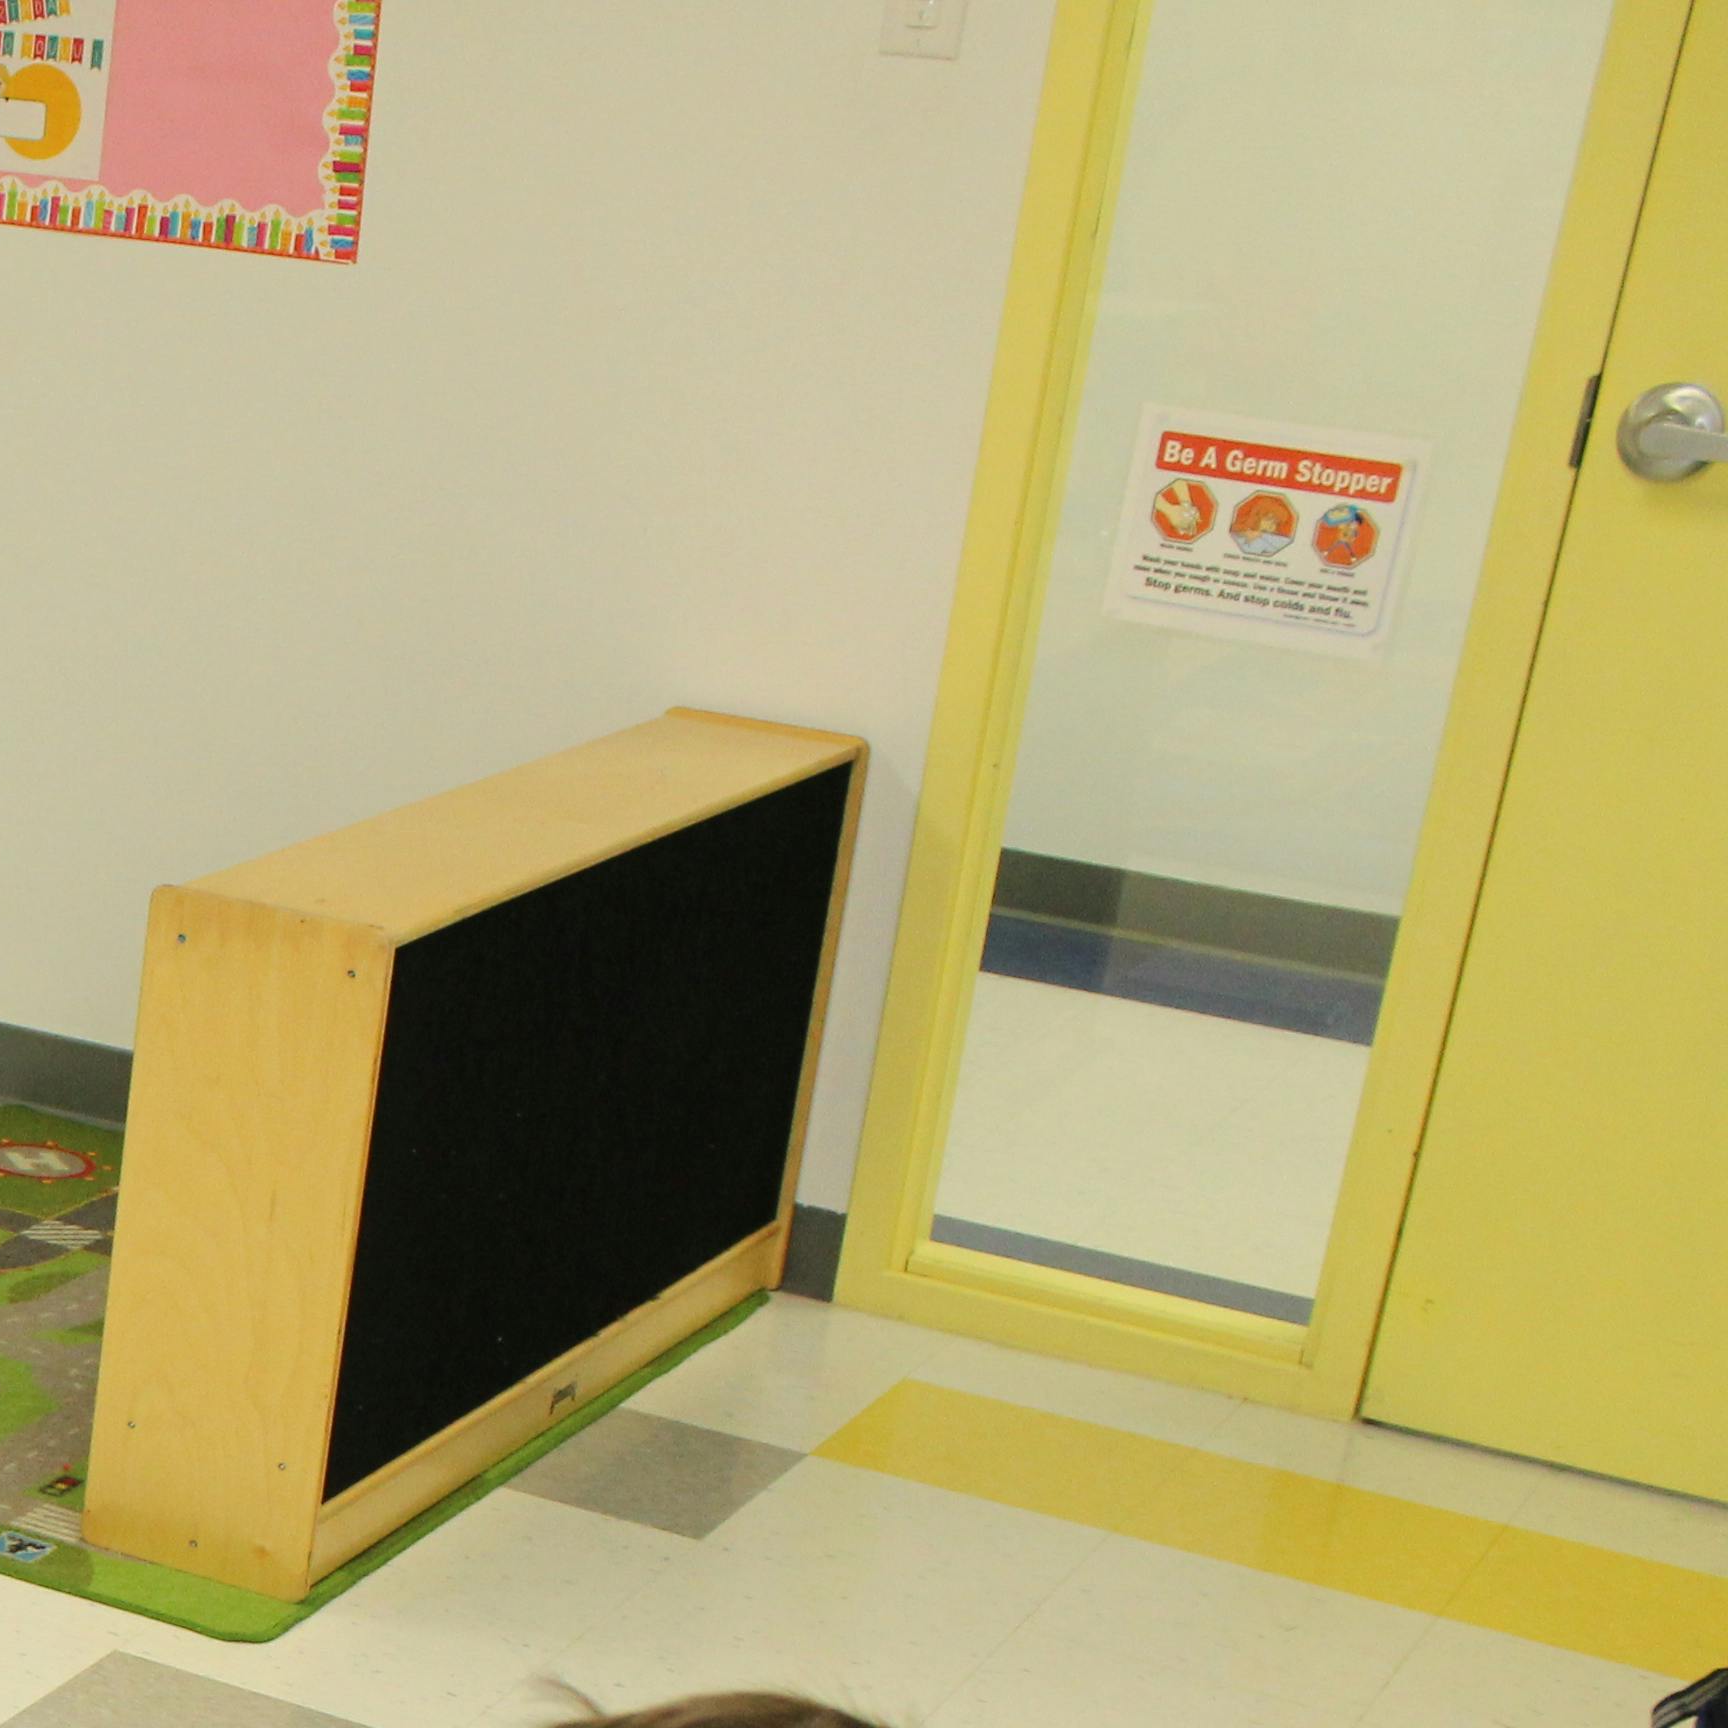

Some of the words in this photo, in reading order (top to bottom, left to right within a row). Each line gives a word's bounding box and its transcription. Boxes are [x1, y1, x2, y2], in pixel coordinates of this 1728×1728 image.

[1163, 440, 1194, 464] Be
[1199, 446, 1218, 469] A
[1225, 449, 1289, 479] Germ
[1295, 459, 1394, 495] Stopper
[1145, 576, 1172, 592] Stop
[1174, 583, 1214, 599] germs.
[1217, 588, 1241, 602] And
[1243, 592, 1270, 608] stop
[1272, 596, 1305, 612] colds
[1308, 602, 1332, 617] and
